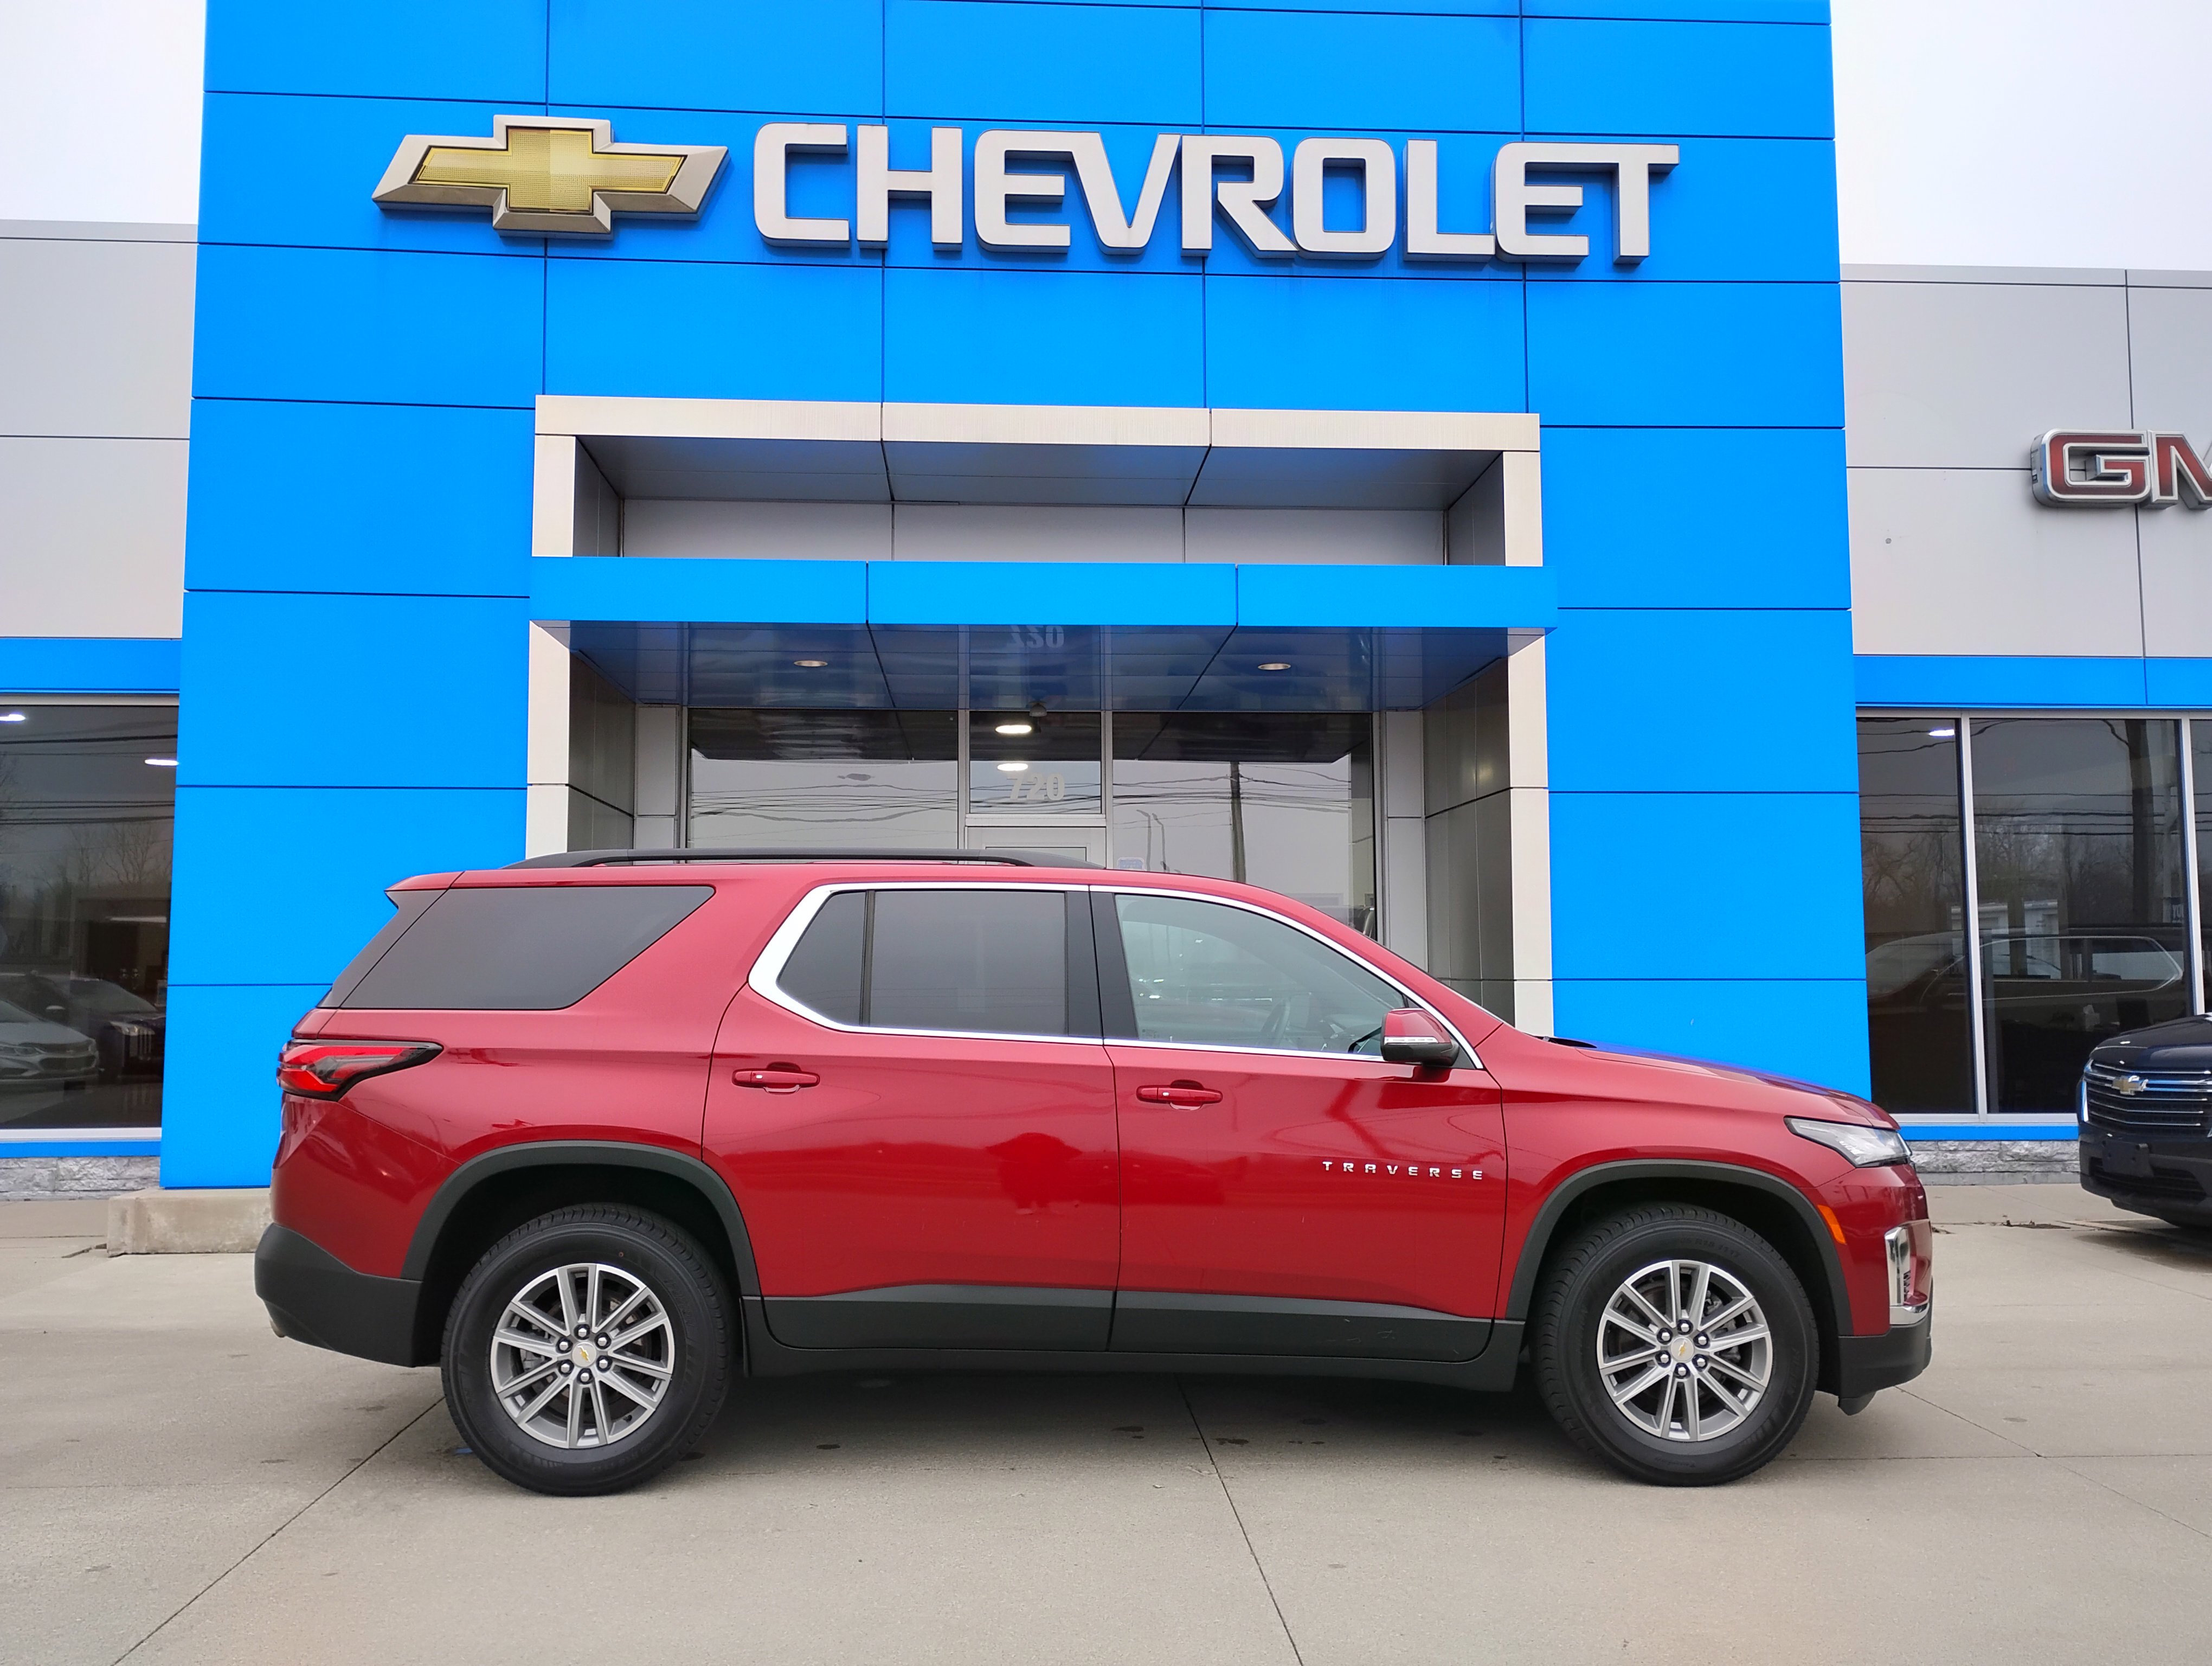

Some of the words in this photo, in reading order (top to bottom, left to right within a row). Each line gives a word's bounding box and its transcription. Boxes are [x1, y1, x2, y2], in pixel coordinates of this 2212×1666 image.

[754, 122, 1680, 262] CHEVROLET
[1007, 772, 1065, 800] 720
[1322, 1161, 1483, 1180] TRAVERSE
